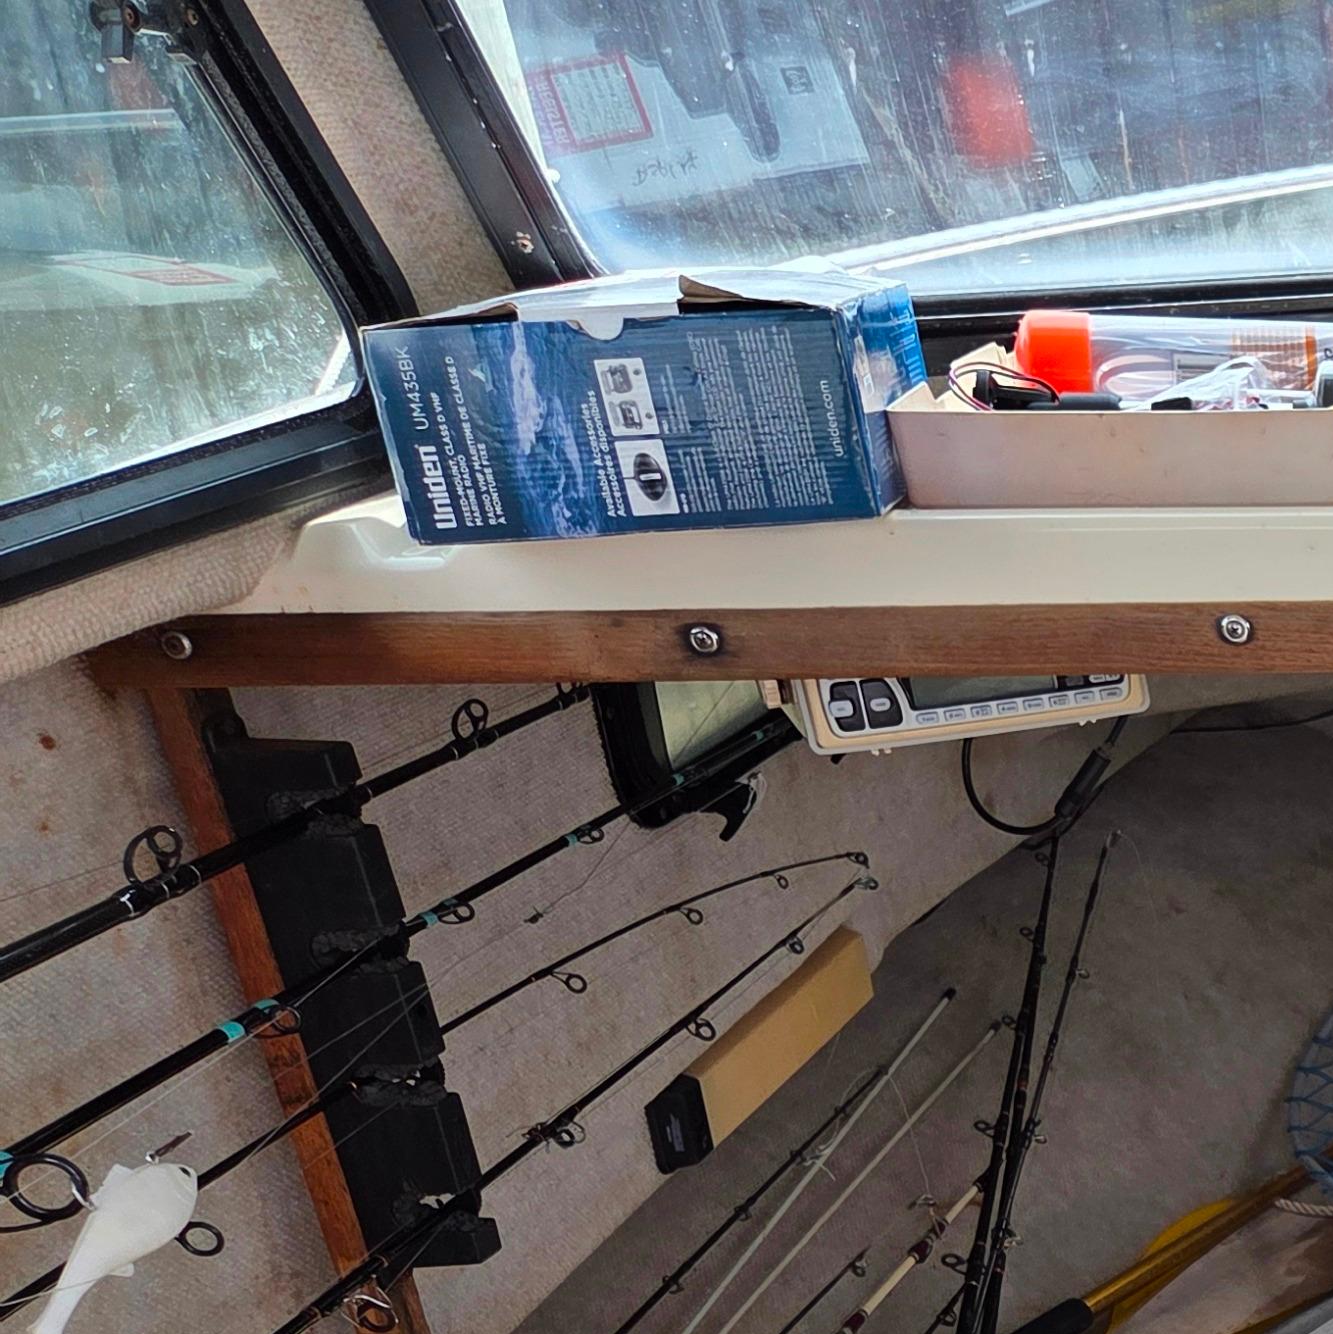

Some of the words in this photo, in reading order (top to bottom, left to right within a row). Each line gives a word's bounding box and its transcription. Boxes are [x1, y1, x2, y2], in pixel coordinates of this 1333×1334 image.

[444, 355, 455, 364] D
[396, 345, 430, 430] UM435BK
[430, 392, 443, 413] VHF
[448, 365, 464, 405] CLASSE
[436, 415, 446, 423] D
[456, 406, 467, 420] DE
[587, 390, 611, 453] disponibles
[819, 380, 845, 458] uniden.com
[438, 425, 455, 456] CLASS
[461, 422, 483, 470] MARITIME
[477, 444, 491, 465] FIXE
[580, 403, 604, 466] Accessories
[418, 445, 458, 530] Uniden
[457, 454, 473, 487] RADIO
[475, 471, 489, 492] VHF
[604, 455, 627, 517] Accessoires
[449, 457, 475, 527] FIXED-MOUNT,
[468, 488, 484, 527] MARINE
[482, 493, 498, 526] RADIO
[485, 467, 505, 515] MONTURE
[597, 468, 617, 518] Available
